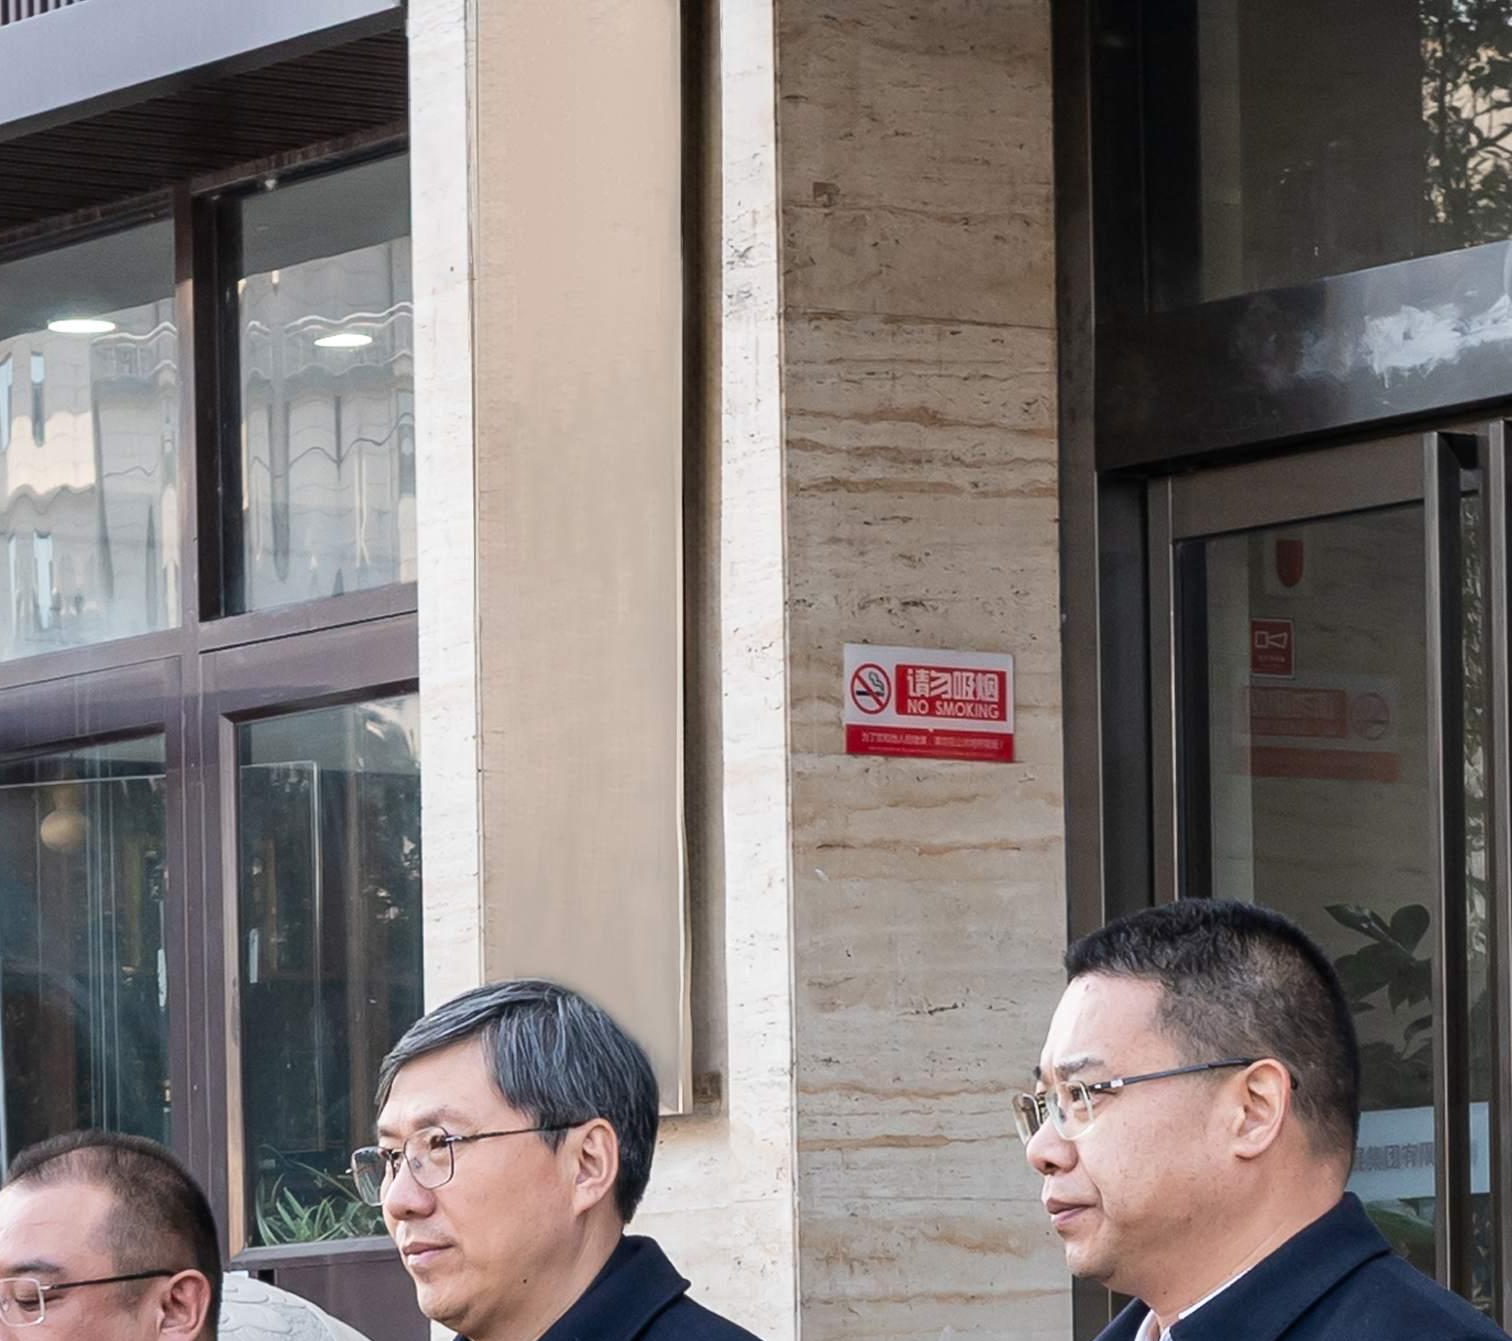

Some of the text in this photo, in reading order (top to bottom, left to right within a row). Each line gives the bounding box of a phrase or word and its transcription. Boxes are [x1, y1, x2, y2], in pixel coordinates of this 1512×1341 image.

[906, 667, 999, 702] 请勿吸烟
[907, 699, 999, 719] NO SMOKING
